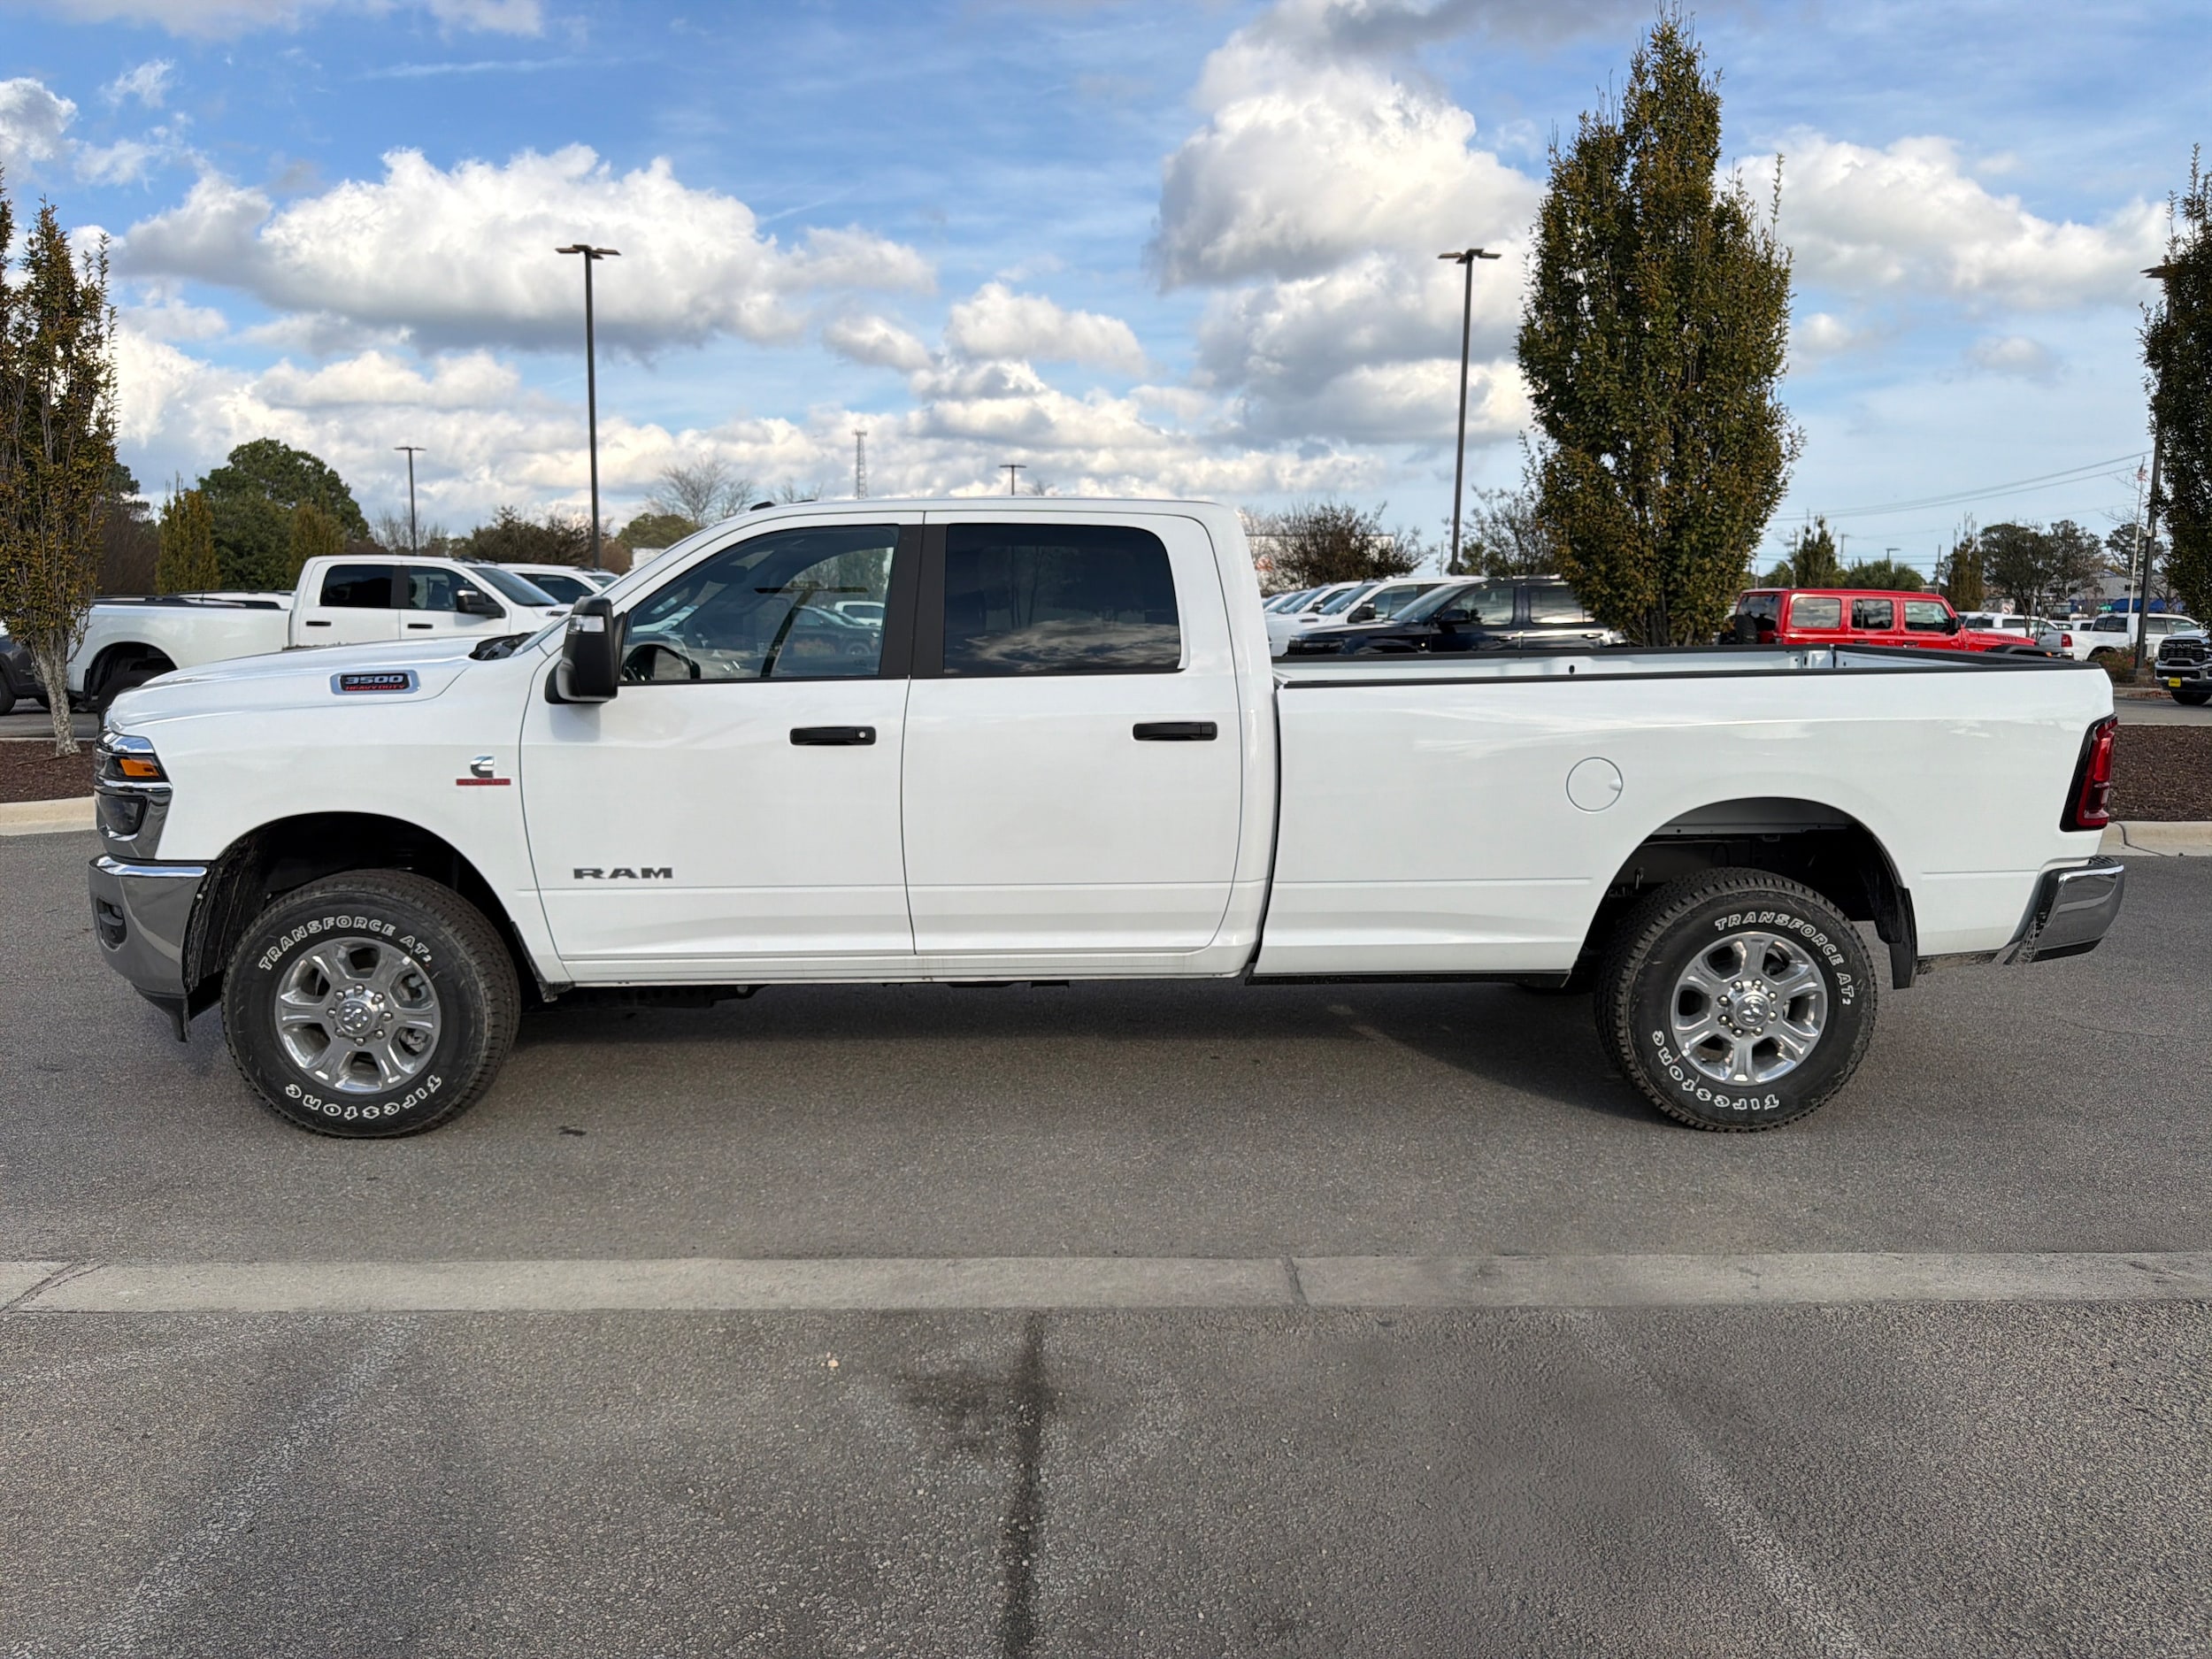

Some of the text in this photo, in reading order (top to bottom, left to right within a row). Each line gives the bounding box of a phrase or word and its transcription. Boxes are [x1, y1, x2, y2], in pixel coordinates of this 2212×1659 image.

[345, 675, 404, 685] 3500
[573, 867, 672, 879] RAM
[258, 914, 397, 972] TRANSFORCE
[1714, 910, 1845, 967] TRANSFORCE
